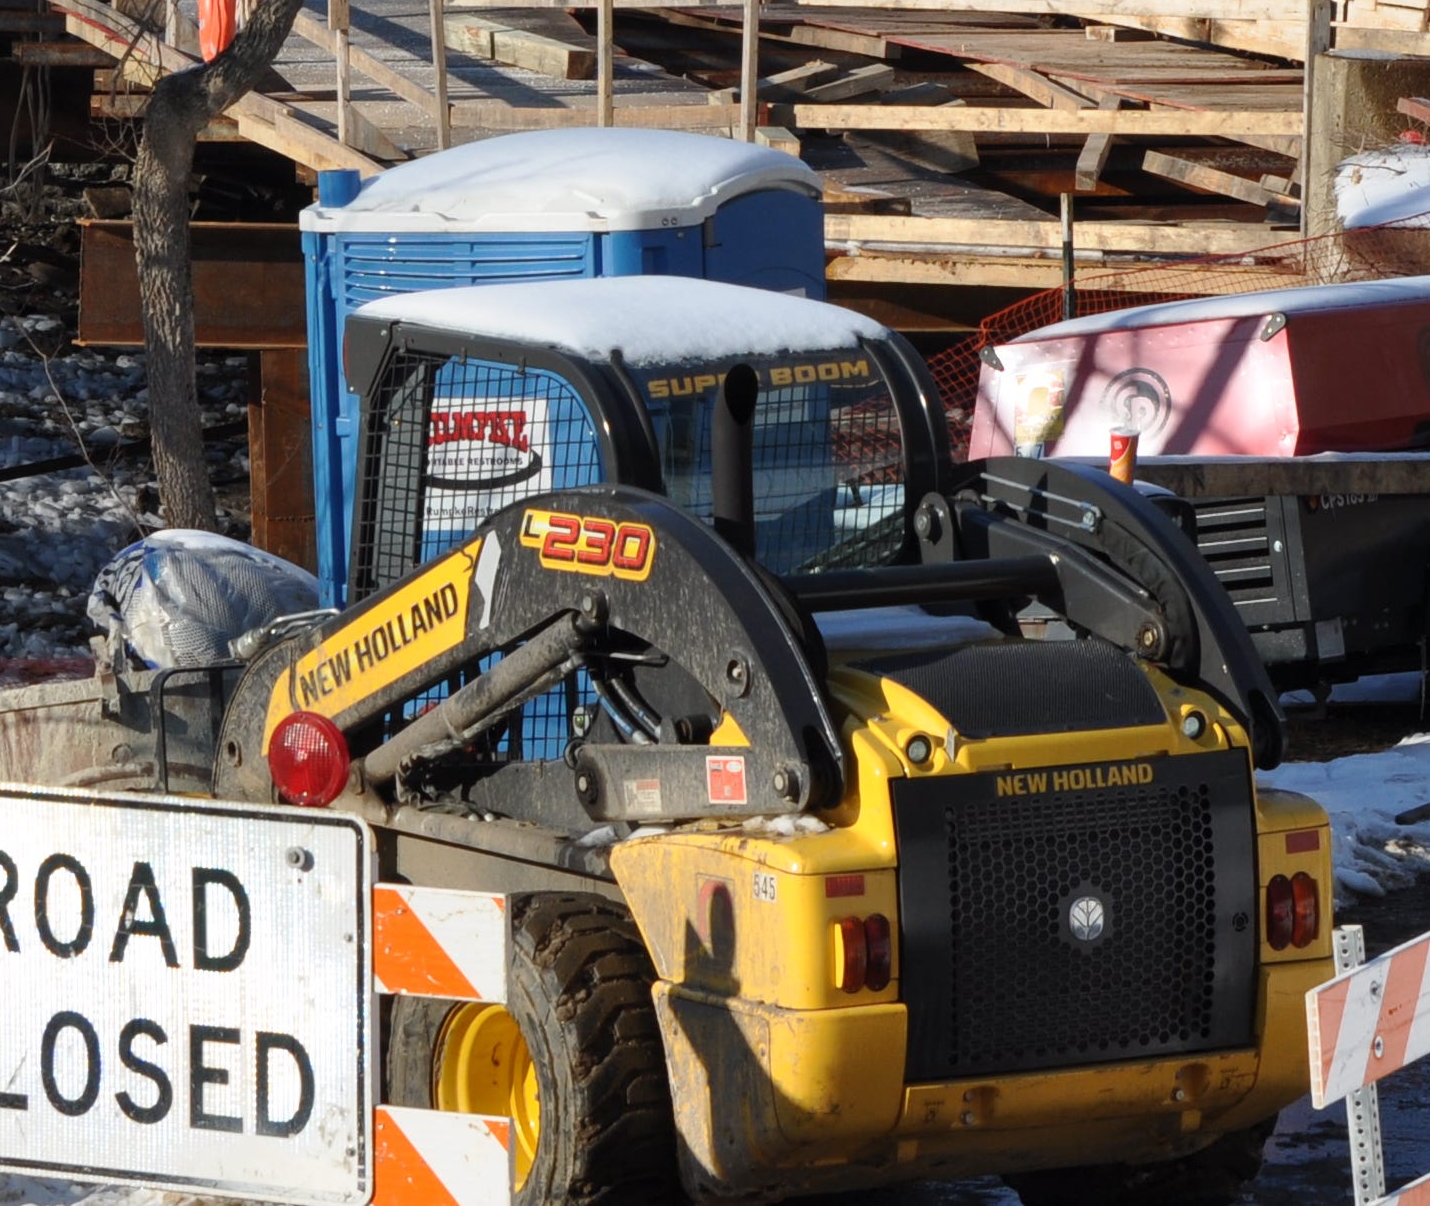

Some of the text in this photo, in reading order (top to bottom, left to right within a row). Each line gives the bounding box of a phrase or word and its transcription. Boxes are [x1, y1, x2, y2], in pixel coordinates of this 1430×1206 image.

[647, 360, 869, 398] SUP BOOM
[428, 457, 523, 467] ORTABLE RESTROOMS
[523, 514, 651, 572] L230
[299, 582, 459, 707] NEW HOLLAND
[996, 763, 1154, 797] NEW HOLLAND
[753, 874, 776, 901] 545
